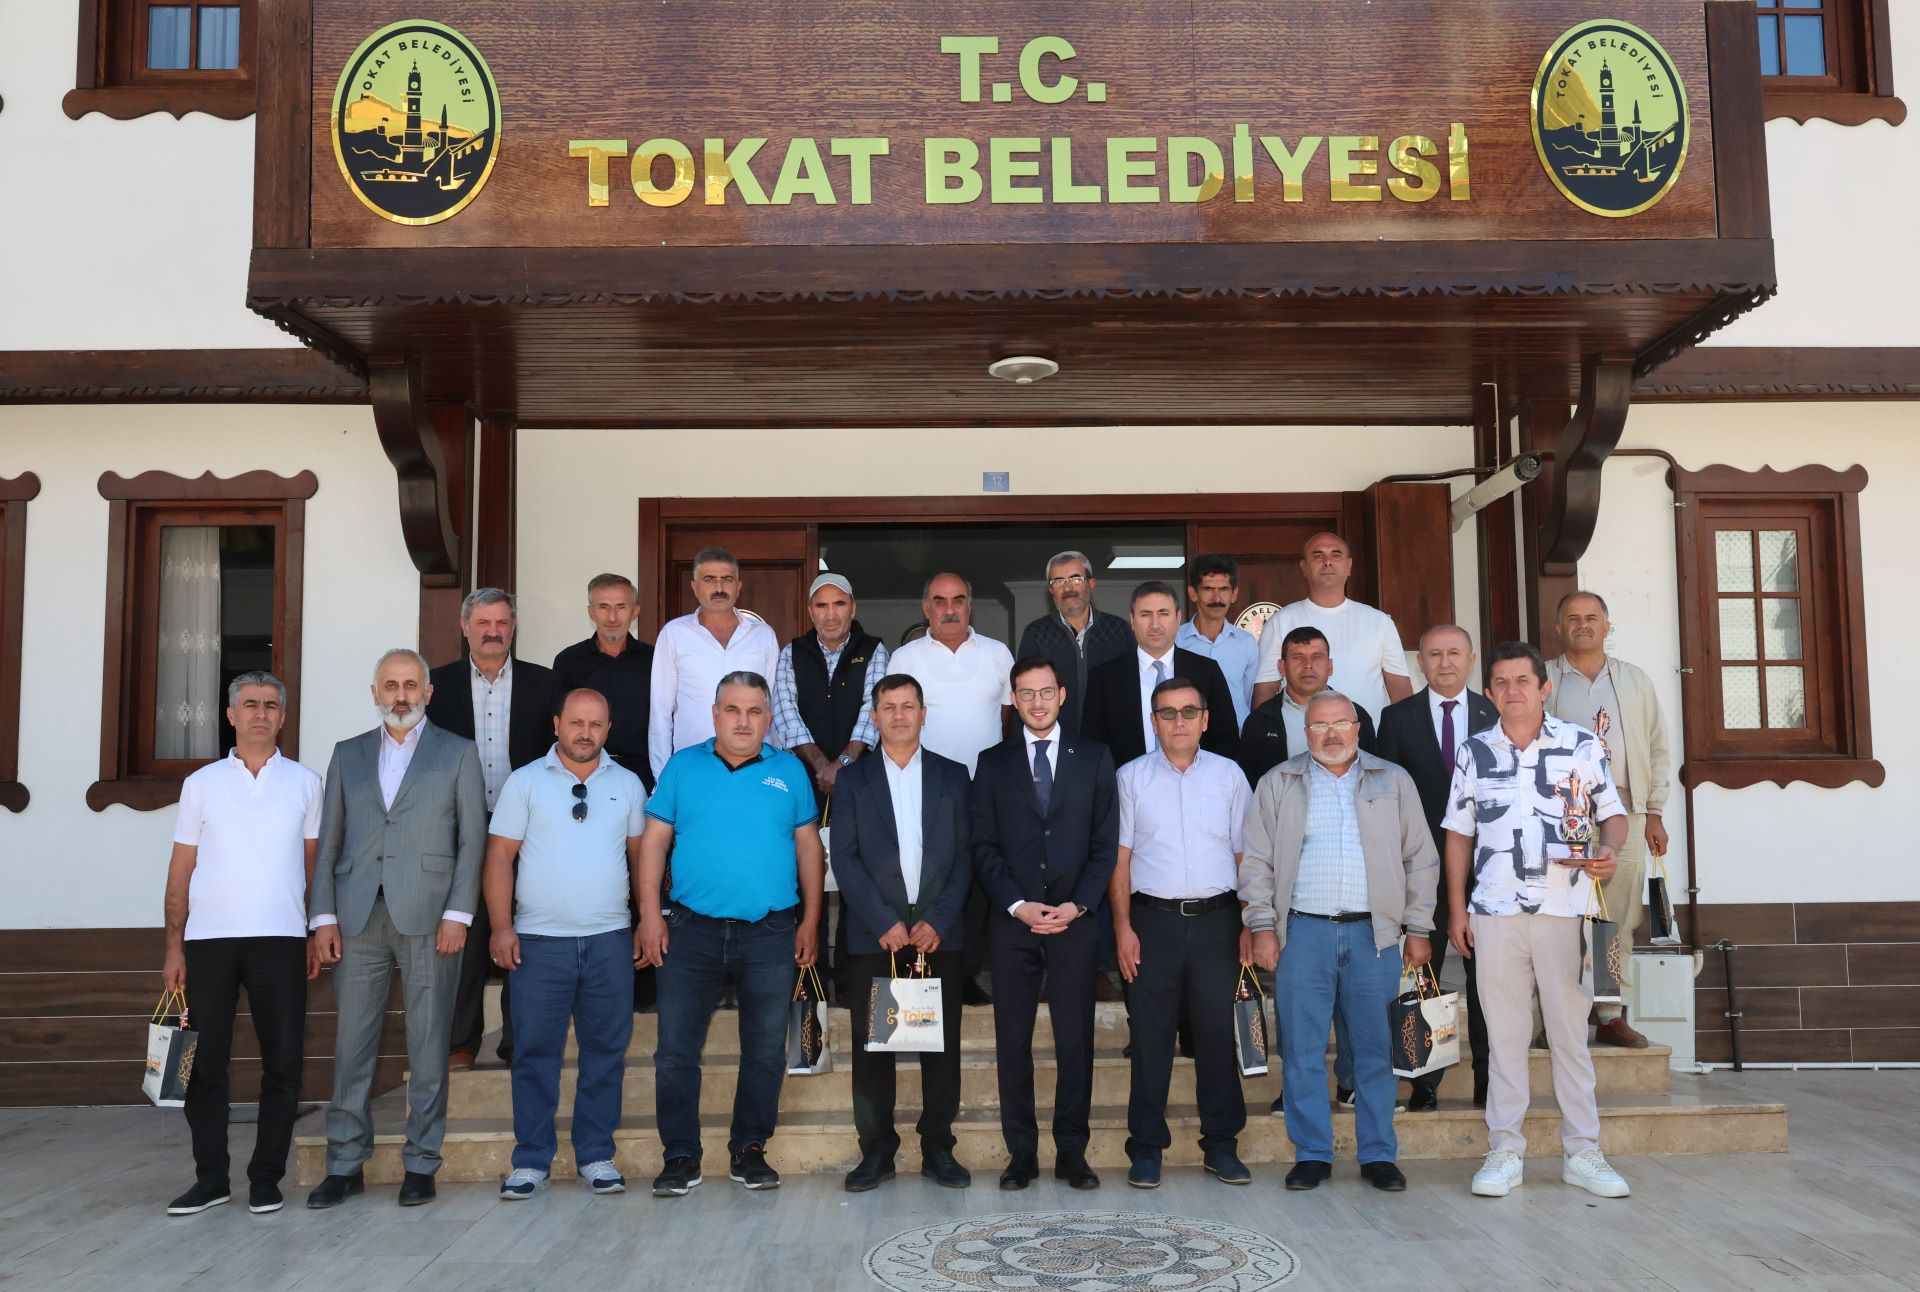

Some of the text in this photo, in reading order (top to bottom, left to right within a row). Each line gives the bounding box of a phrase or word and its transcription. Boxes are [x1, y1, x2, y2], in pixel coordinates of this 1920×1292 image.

[361, 39, 475, 103] TOKAT BELEDİYESİ
[941, 36, 1106, 104] T.C.
[1556, 38, 1664, 98] TOKAT BELEDİYESİ
[568, 122, 1471, 207] TOKAT BELEDİYESİ
